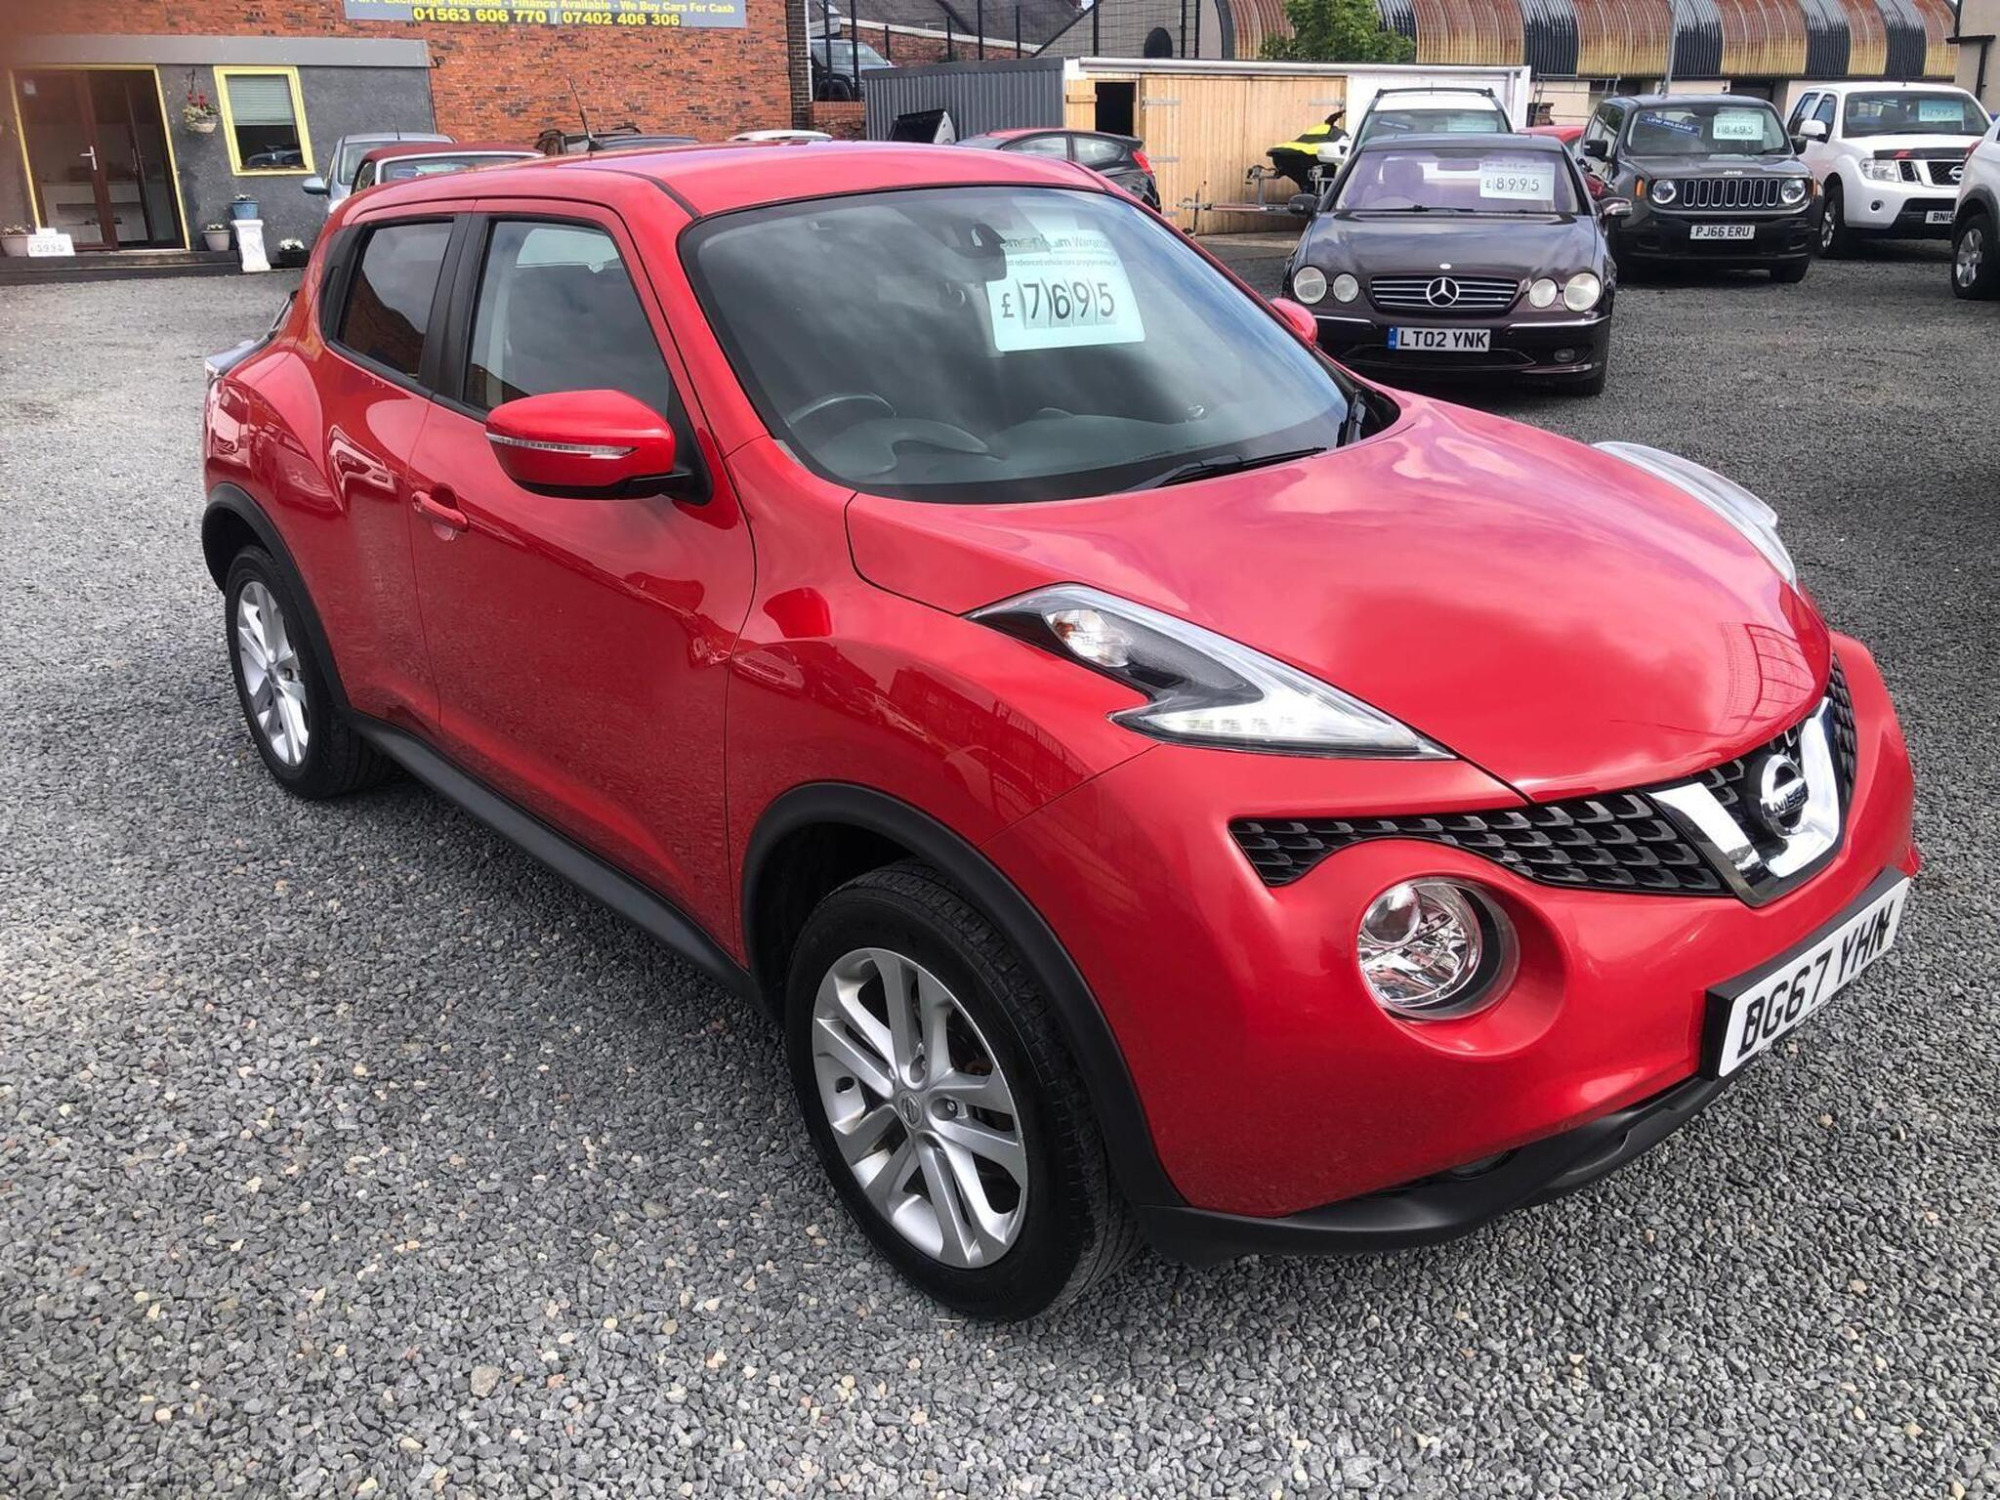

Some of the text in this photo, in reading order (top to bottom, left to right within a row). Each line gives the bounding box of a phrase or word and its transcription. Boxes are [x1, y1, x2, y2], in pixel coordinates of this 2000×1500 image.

[620, 1, 637, 10] We
[639, 1, 661, 13] Buy
[662, 2, 687, 12] Cars
[690, 3, 706, 12] For
[709, 4, 735, 13] Cash
[412, 7, 471, 21] 01563
[475, 9, 509, 22] 606
[513, 10, 547, 23] 770
[562, 11, 613, 25] 07402
[617, 13, 647, 25] 406
[651, 14, 680, 26] 306
[1485, 177, 1540, 192] £8995
[1695, 226, 1750, 237] PJ66 ERU
[1001, 282, 1115, 319] £7695
[1400, 330, 1447, 347] LT02
[1452, 331, 1488, 348] YNK
[1836, 899, 1895, 985] YHN
